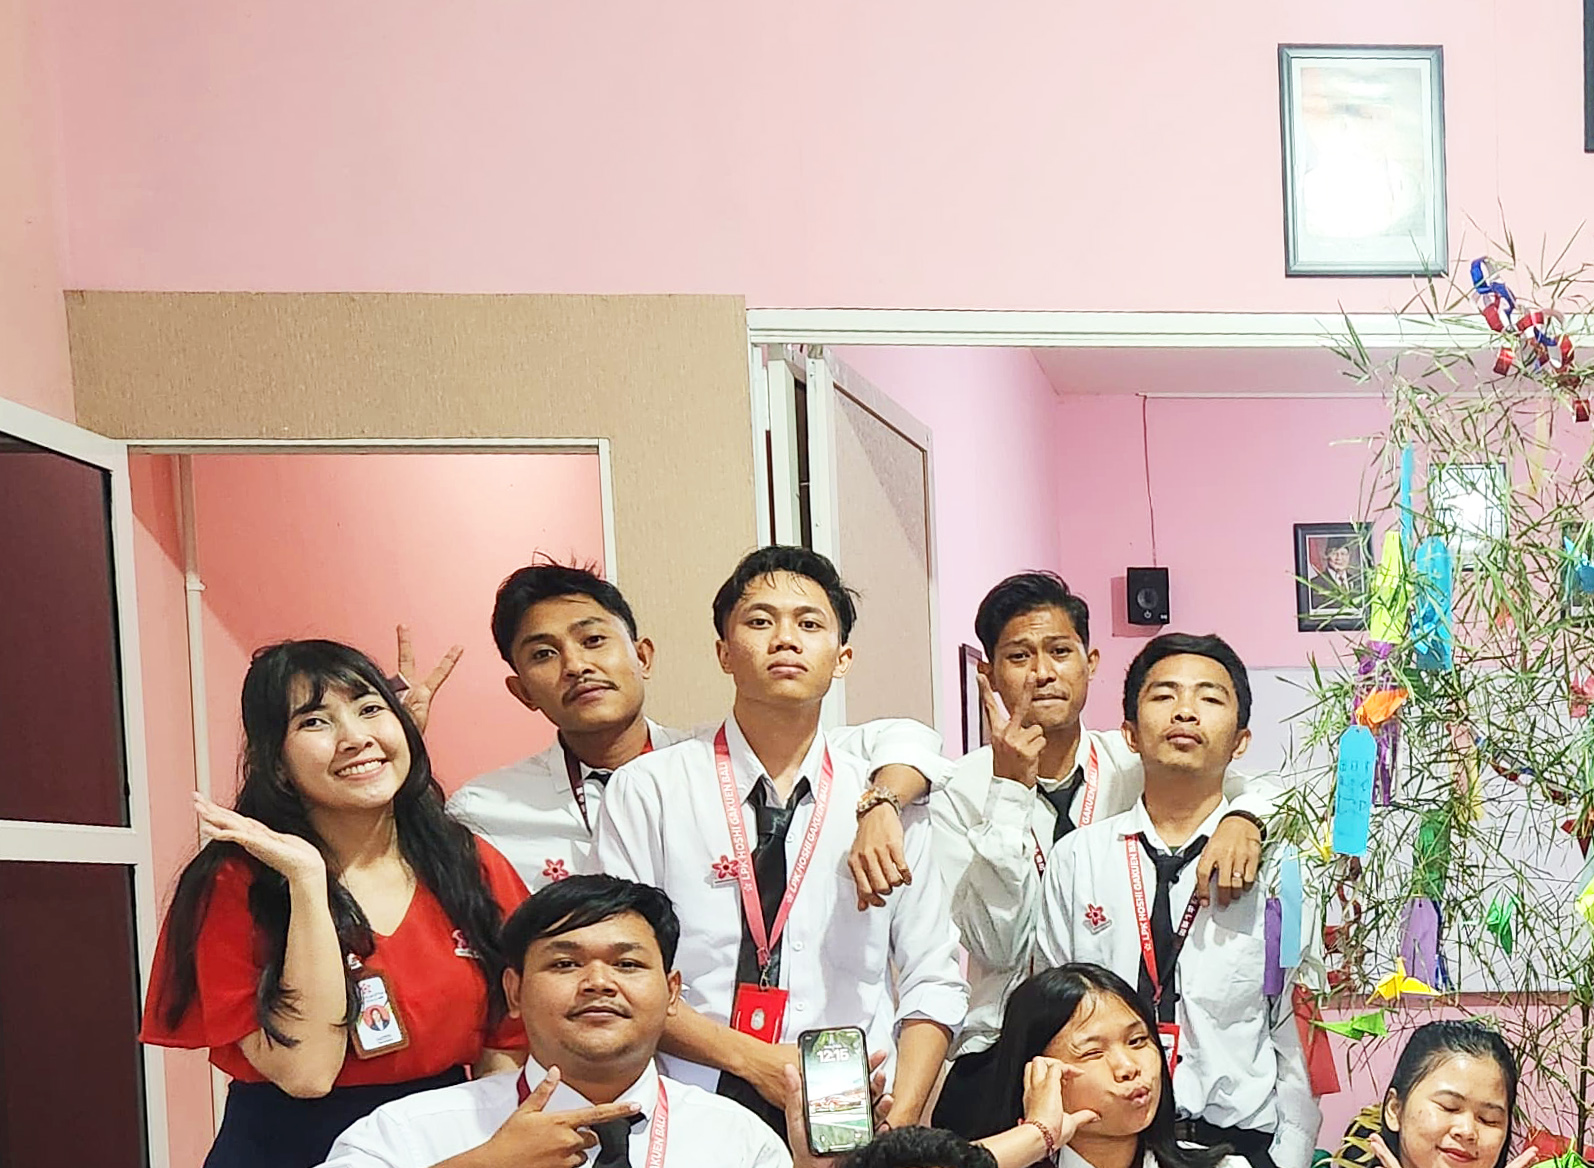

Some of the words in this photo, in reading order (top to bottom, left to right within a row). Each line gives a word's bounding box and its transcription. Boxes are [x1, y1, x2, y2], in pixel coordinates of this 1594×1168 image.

[719, 762, 731, 786] BALI
[723, 786, 740, 826] GAKUEN
[1082, 788, 1096, 824] GAKUEN
[732, 825, 747, 858] HOSHI
[789, 872, 804, 894] LPK
[797, 842, 814, 873] HOSHI
[809, 802, 826, 844] GAKUEN
[738, 857, 751, 880] LPK
[1129, 854, 1143, 891] GAKUEN
[1134, 891, 1148, 922] HOSHI
[1138, 922, 1150, 942] LPK
[654, 1115, 666, 1140] BALI
